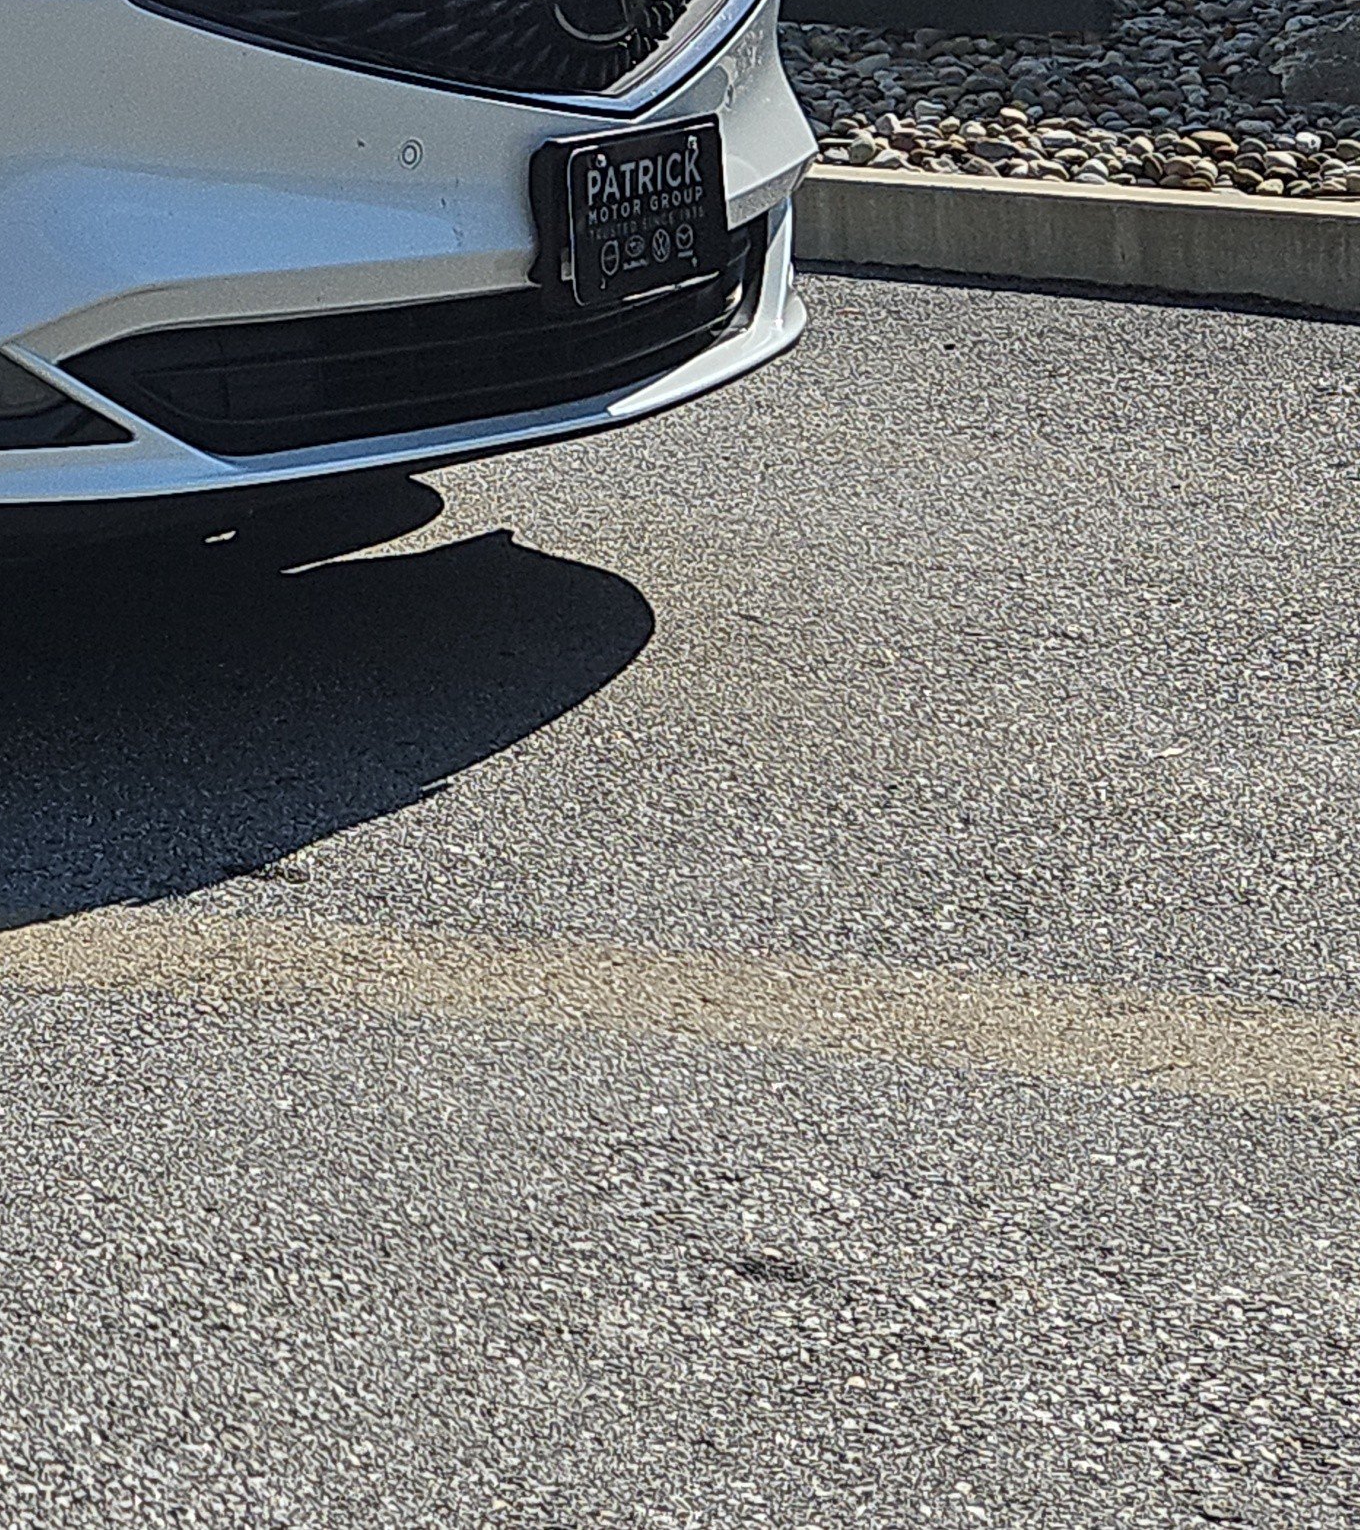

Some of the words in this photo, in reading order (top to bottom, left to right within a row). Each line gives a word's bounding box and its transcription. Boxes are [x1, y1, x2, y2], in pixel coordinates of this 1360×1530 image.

[587, 147, 702, 206] PATRICK
[588, 199, 641, 225] MOTOR
[649, 185, 703, 211] GROUP
